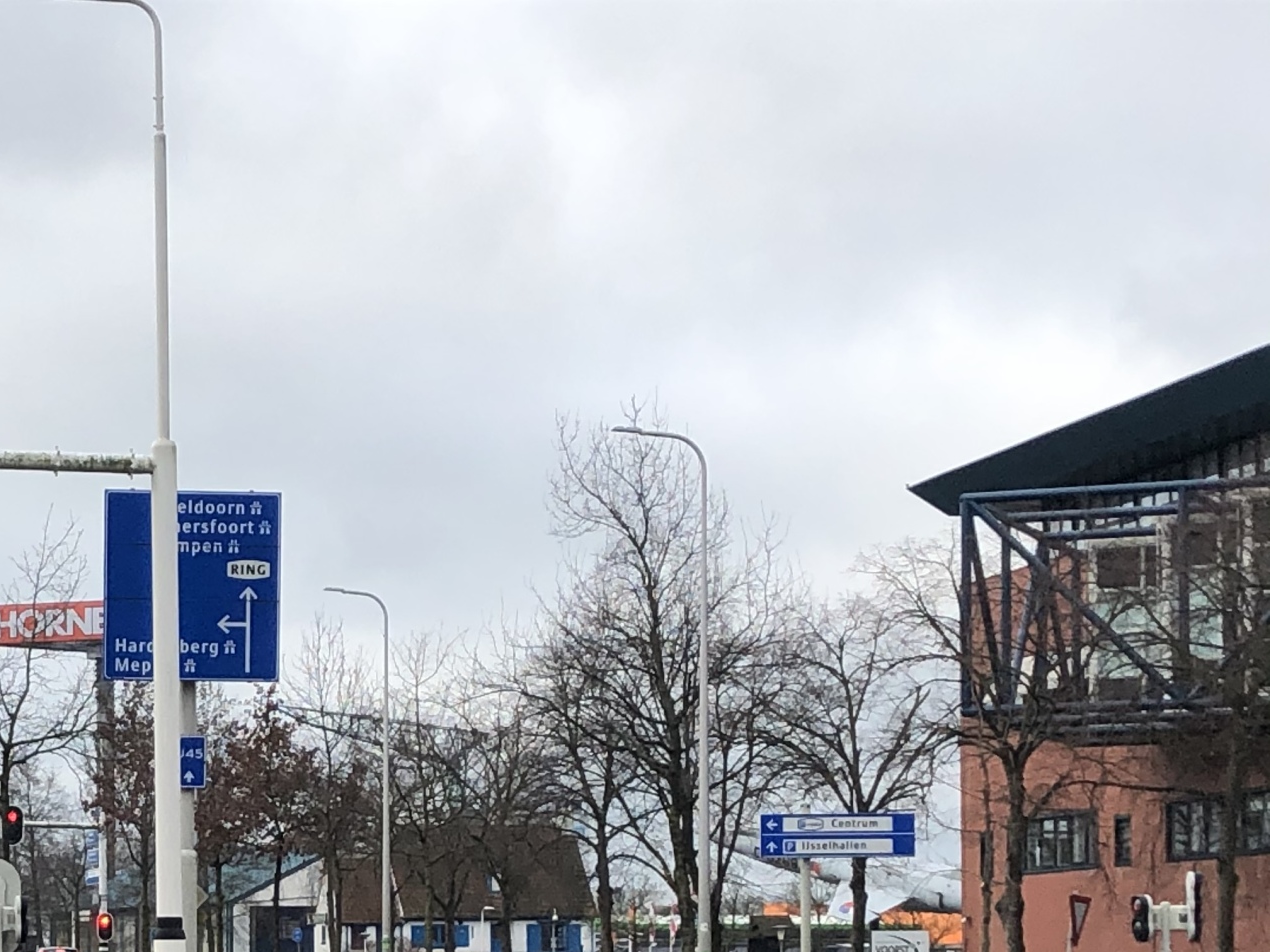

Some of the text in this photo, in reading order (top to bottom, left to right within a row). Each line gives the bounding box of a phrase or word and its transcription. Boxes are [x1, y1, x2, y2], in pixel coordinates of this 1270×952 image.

[177, 499, 245, 515] eldoorn
[177, 540, 223, 557] mpen
[230, 564, 267, 576] RING
[114, 637, 220, 658] Harberg
[114, 657, 152, 676] Mep
[831, 818, 879, 829] Centrum
